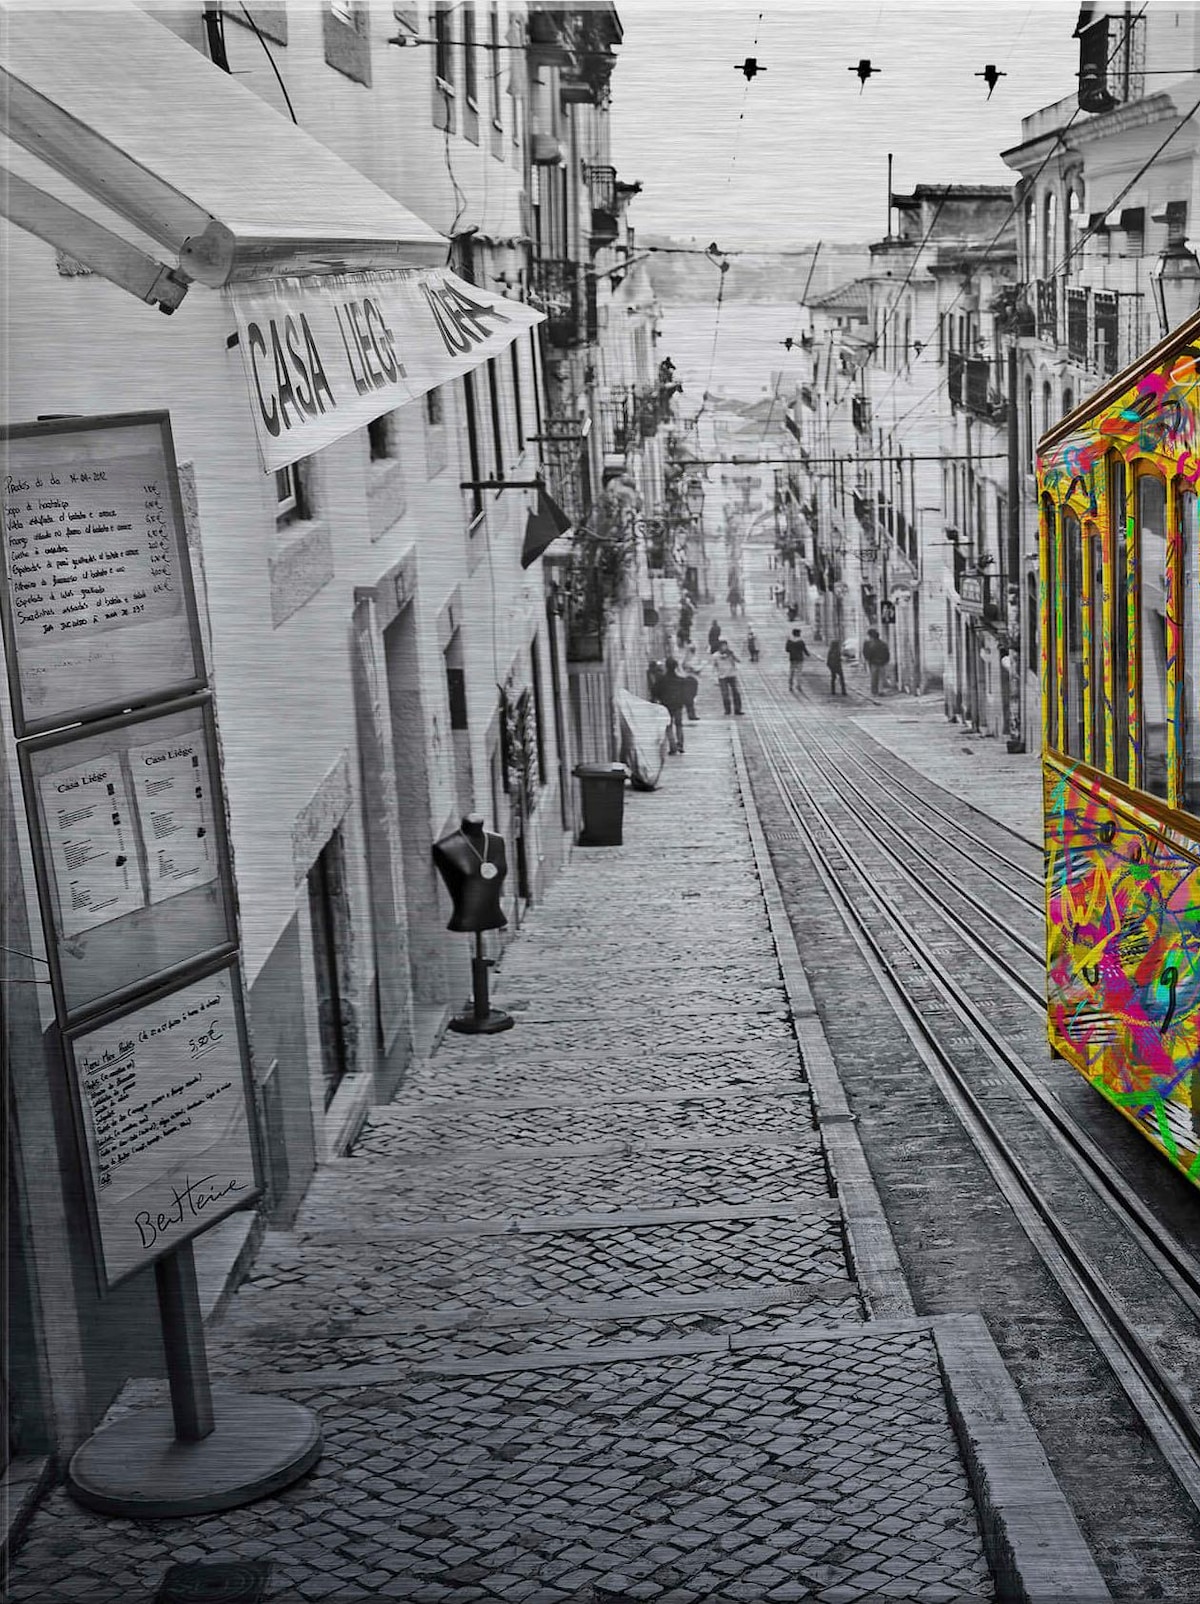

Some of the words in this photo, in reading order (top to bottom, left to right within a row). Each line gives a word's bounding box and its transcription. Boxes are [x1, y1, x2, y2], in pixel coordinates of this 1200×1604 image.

[248, 312, 337, 437] CASA
[145, 755, 166, 766] Casa
[57, 782, 80, 793] Casa
